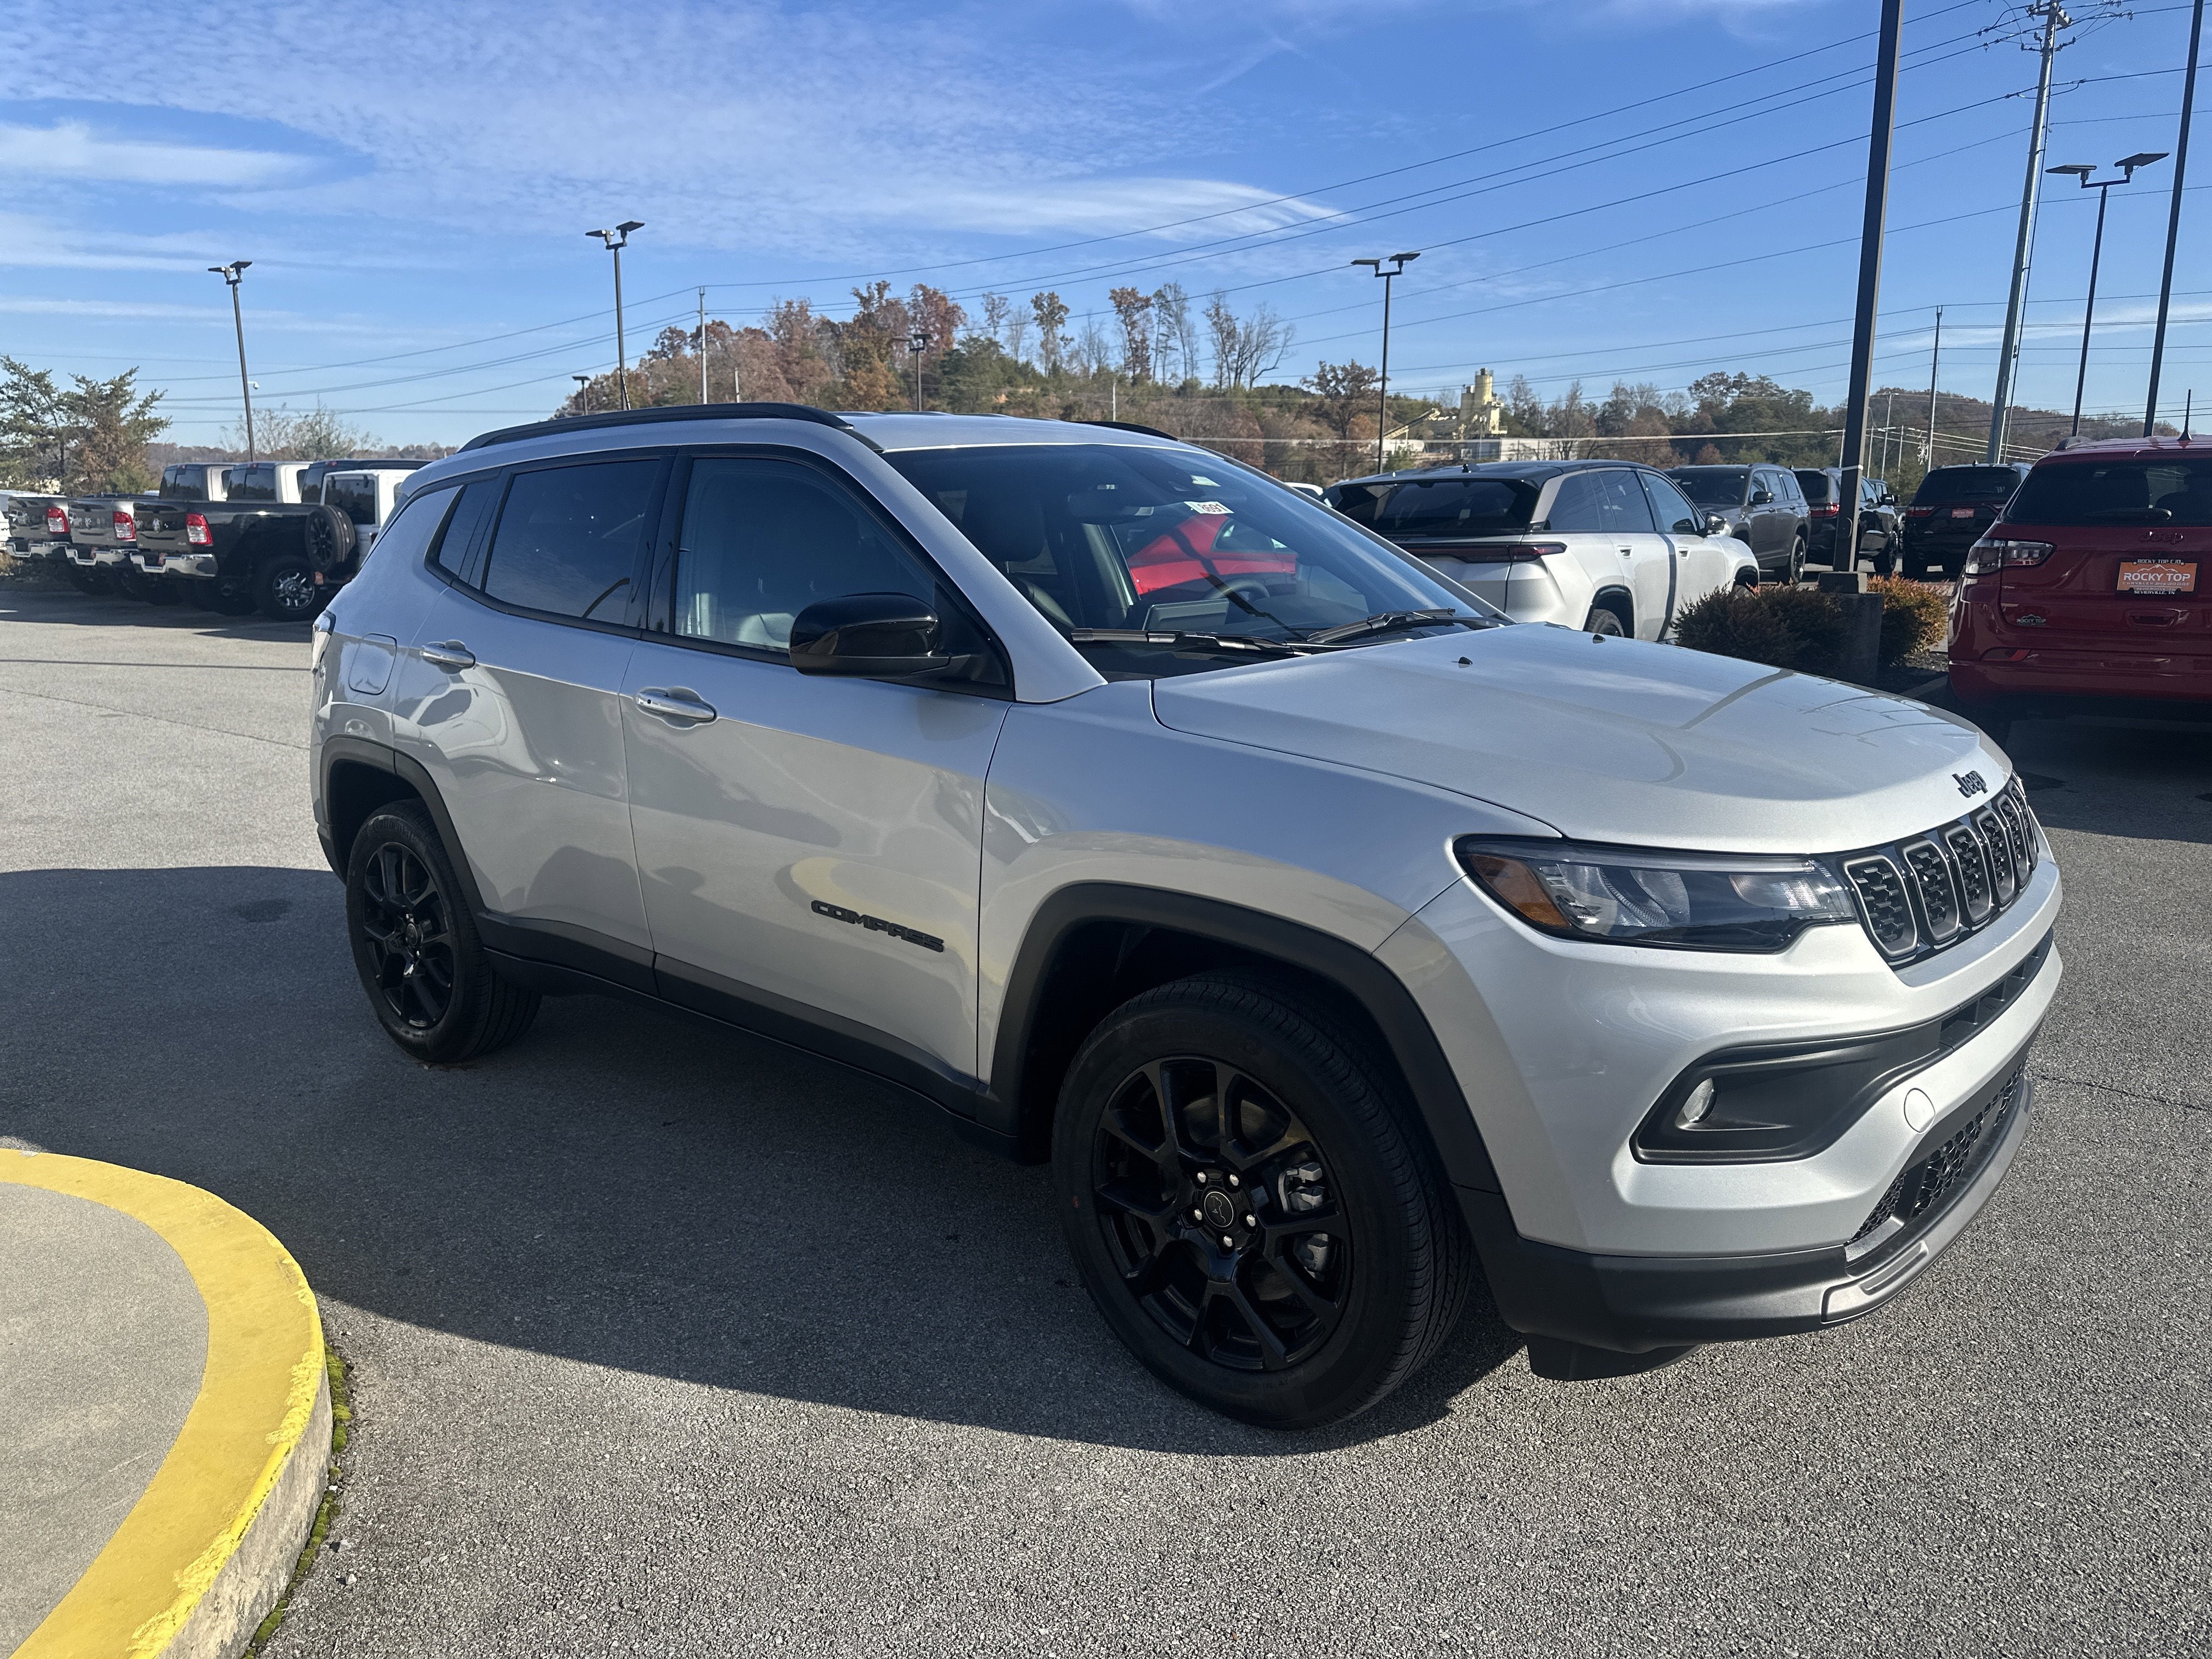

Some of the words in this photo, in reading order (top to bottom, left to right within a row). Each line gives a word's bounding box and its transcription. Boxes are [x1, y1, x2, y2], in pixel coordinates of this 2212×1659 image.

[2123, 572, 2164, 581] ROCKY
[2166, 573, 2191, 582] TOP
[1951, 770, 1988, 798] Jeep
[811, 900, 945, 953] COMPASS
